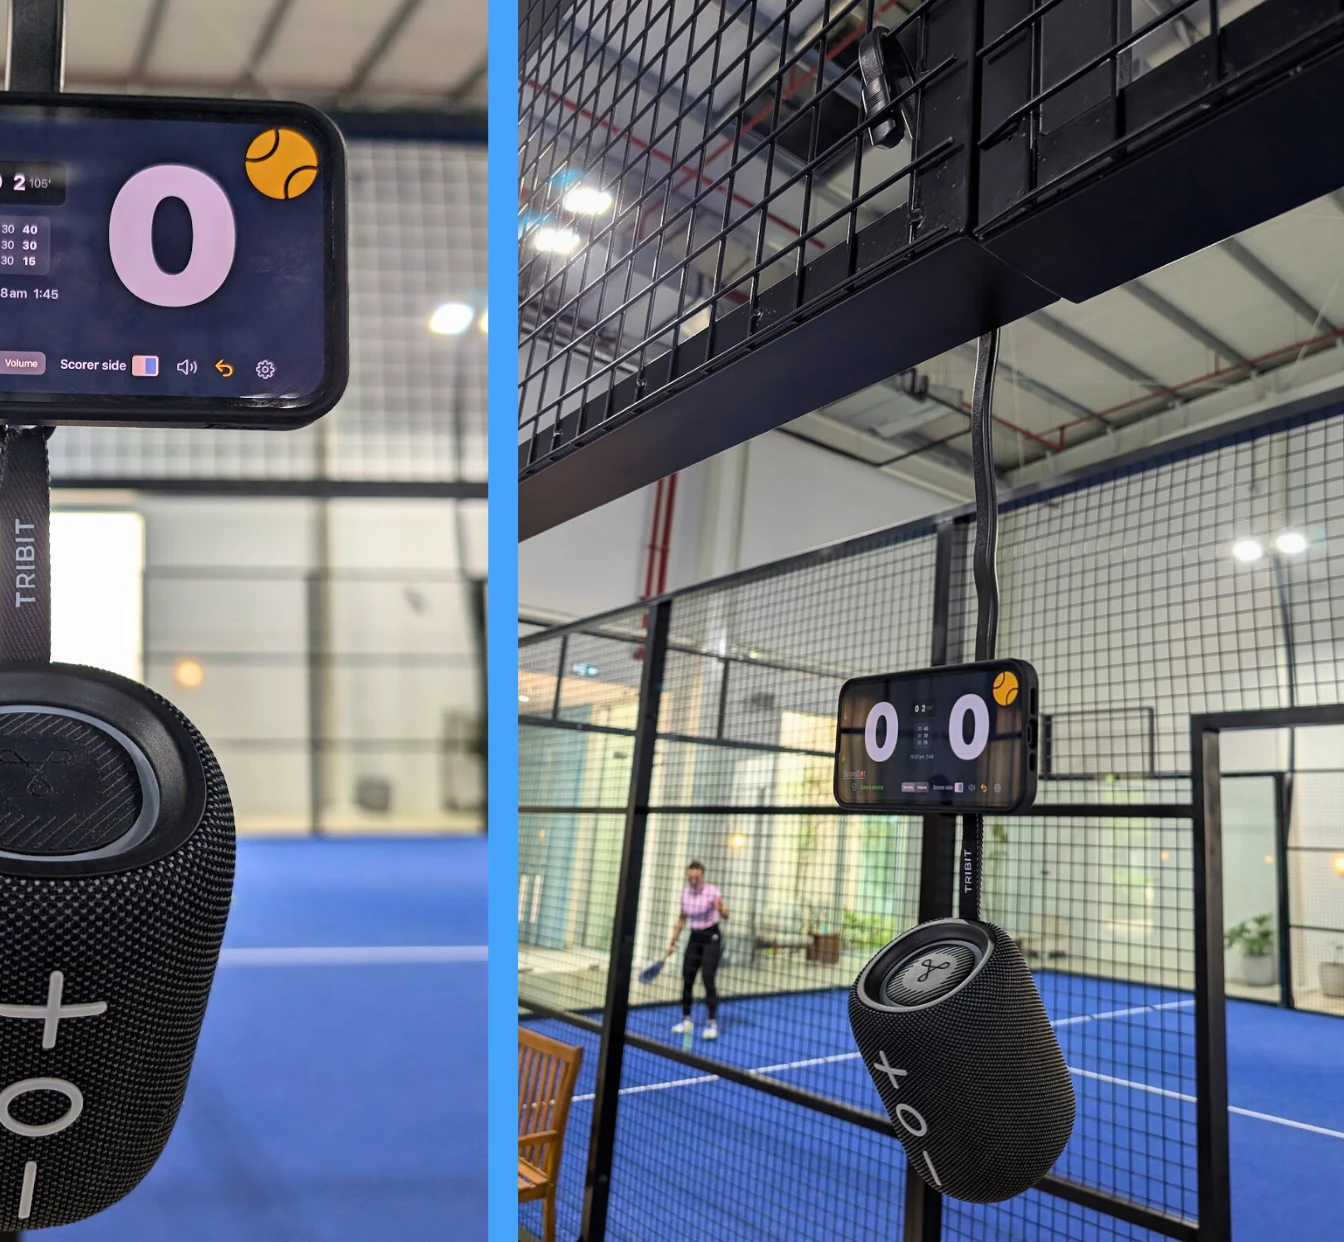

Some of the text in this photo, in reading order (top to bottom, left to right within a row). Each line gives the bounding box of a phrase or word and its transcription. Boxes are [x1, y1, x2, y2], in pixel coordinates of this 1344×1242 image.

[13, 173, 26, 191] 2
[1, 224, 38, 235] 30 40
[109, 164, 236, 308] 0
[1, 240, 38, 251] 30 30
[0, 256, 36, 266] 30 15
[33, 289, 59, 299] 1:45
[5, 358, 38, 368] Volume
[60, 359, 127, 371] Scorer side
[14, 518, 36, 608] TRIBIT
[921, 704, 926, 713] 2
[864, 701, 899, 762] 0
[949, 693, 990, 760] 0
[964, 849, 972, 893] TRIBIT
